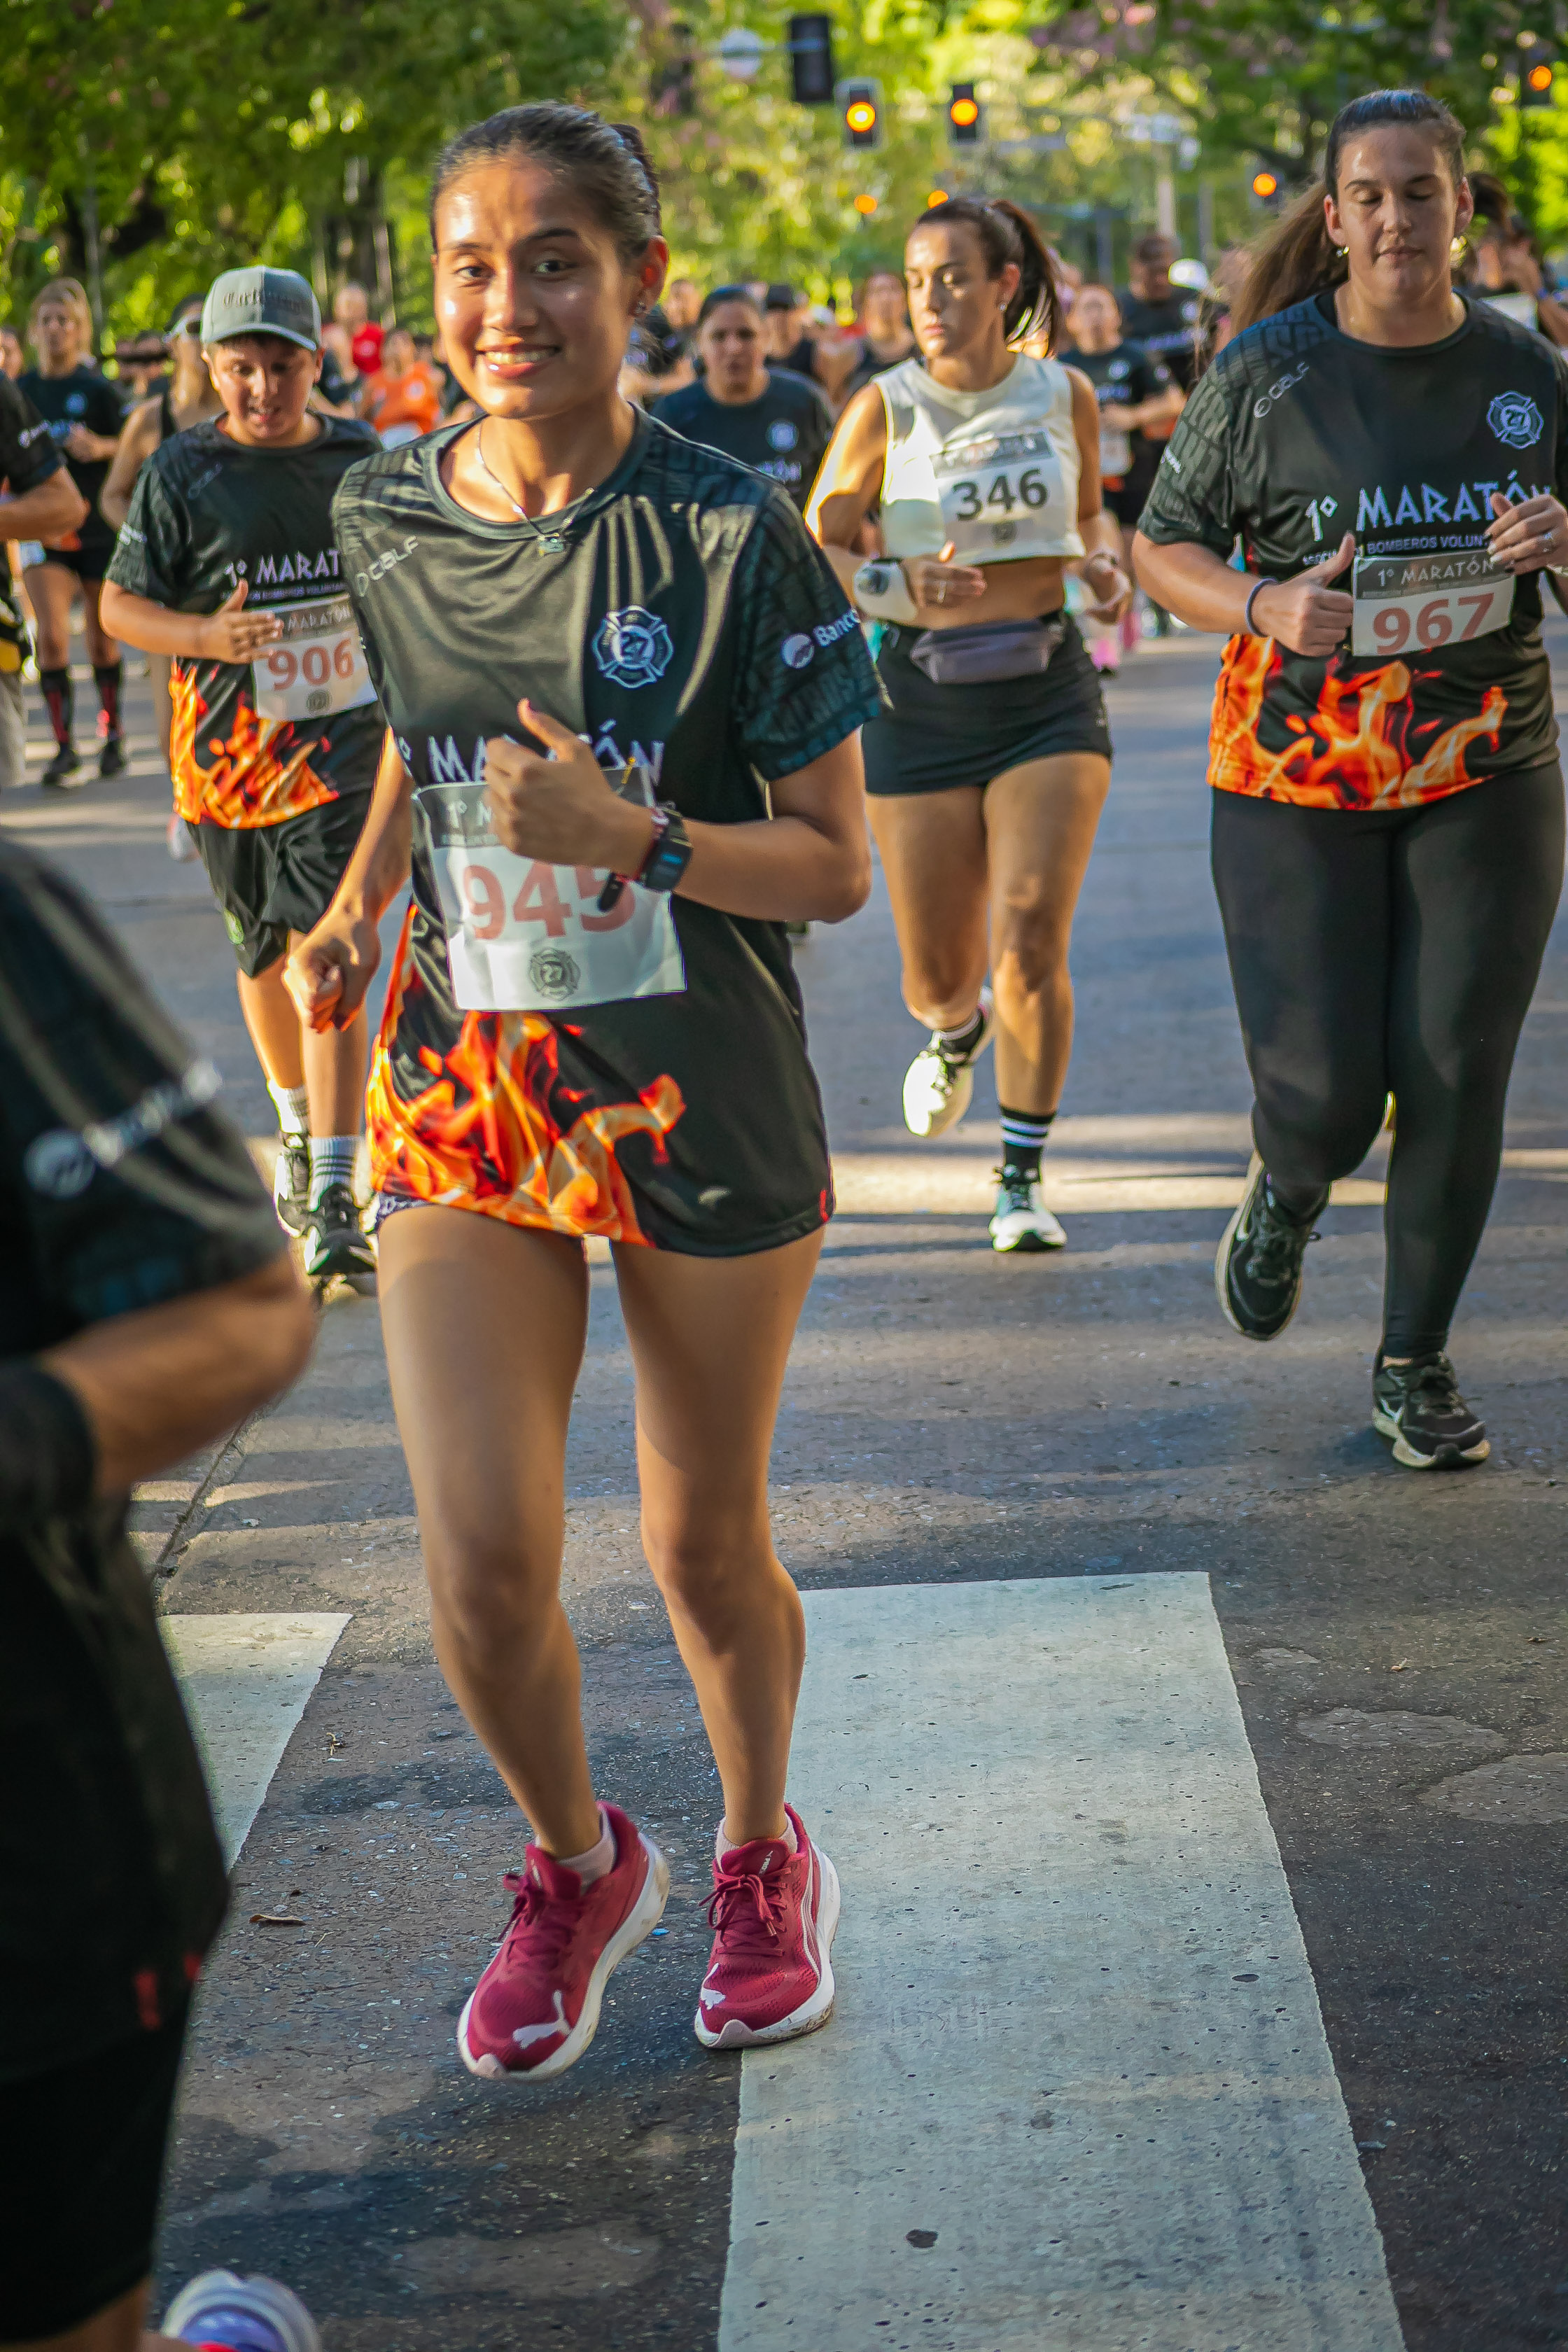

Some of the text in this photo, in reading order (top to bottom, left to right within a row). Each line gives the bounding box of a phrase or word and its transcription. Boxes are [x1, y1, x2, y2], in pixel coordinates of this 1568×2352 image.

[952, 468, 1049, 522] 346
[255, 549, 341, 585] MARAT
[1367, 534, 1488, 555] BOMBEROS VOLUN
[1373, 592, 1495, 656] 967
[268, 638, 354, 692] 906
[463, 861, 637, 940] 945
